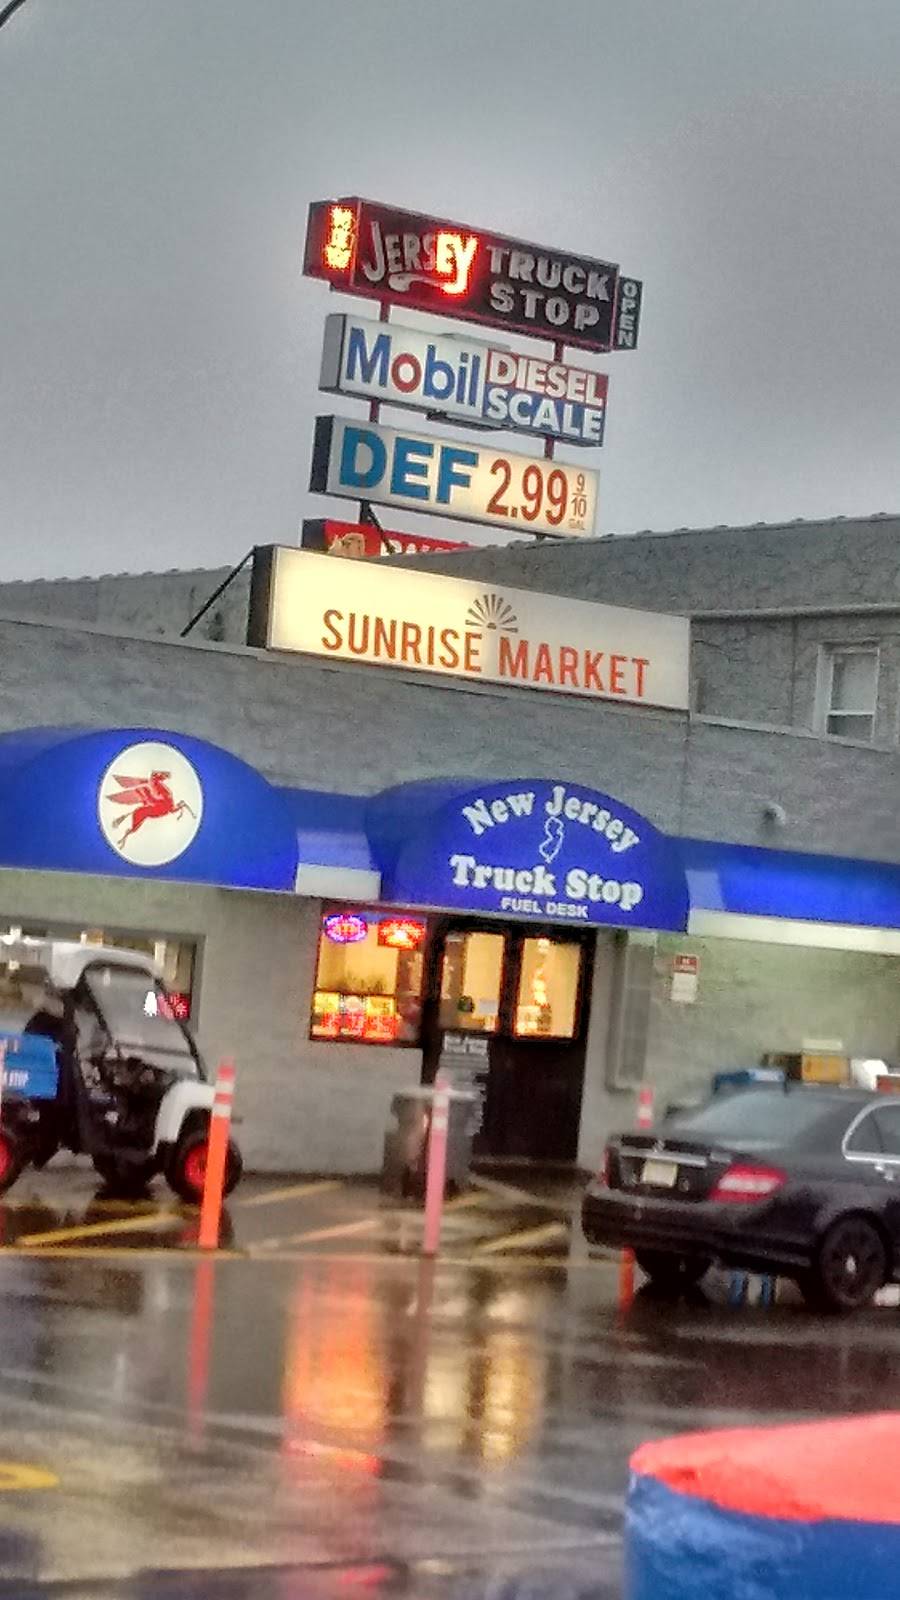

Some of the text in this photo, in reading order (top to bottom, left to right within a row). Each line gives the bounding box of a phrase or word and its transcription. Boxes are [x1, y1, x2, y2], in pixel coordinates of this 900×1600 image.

[487, 245, 610, 302] TRUCK
[490, 282, 600, 331] STOP
[619, 281, 638, 348] OPEN
[345, 327, 606, 408] Mobil DIESEL
[487, 387, 603, 439] SCALE
[339, 426, 568, 526] DEF 2.99
[321, 609, 650, 698] SUNRISE MARKET
[462, 785, 641, 853] New Jersey
[450, 854, 644, 911] Truck Stop
[501, 897, 589, 918] FUEL DESK
